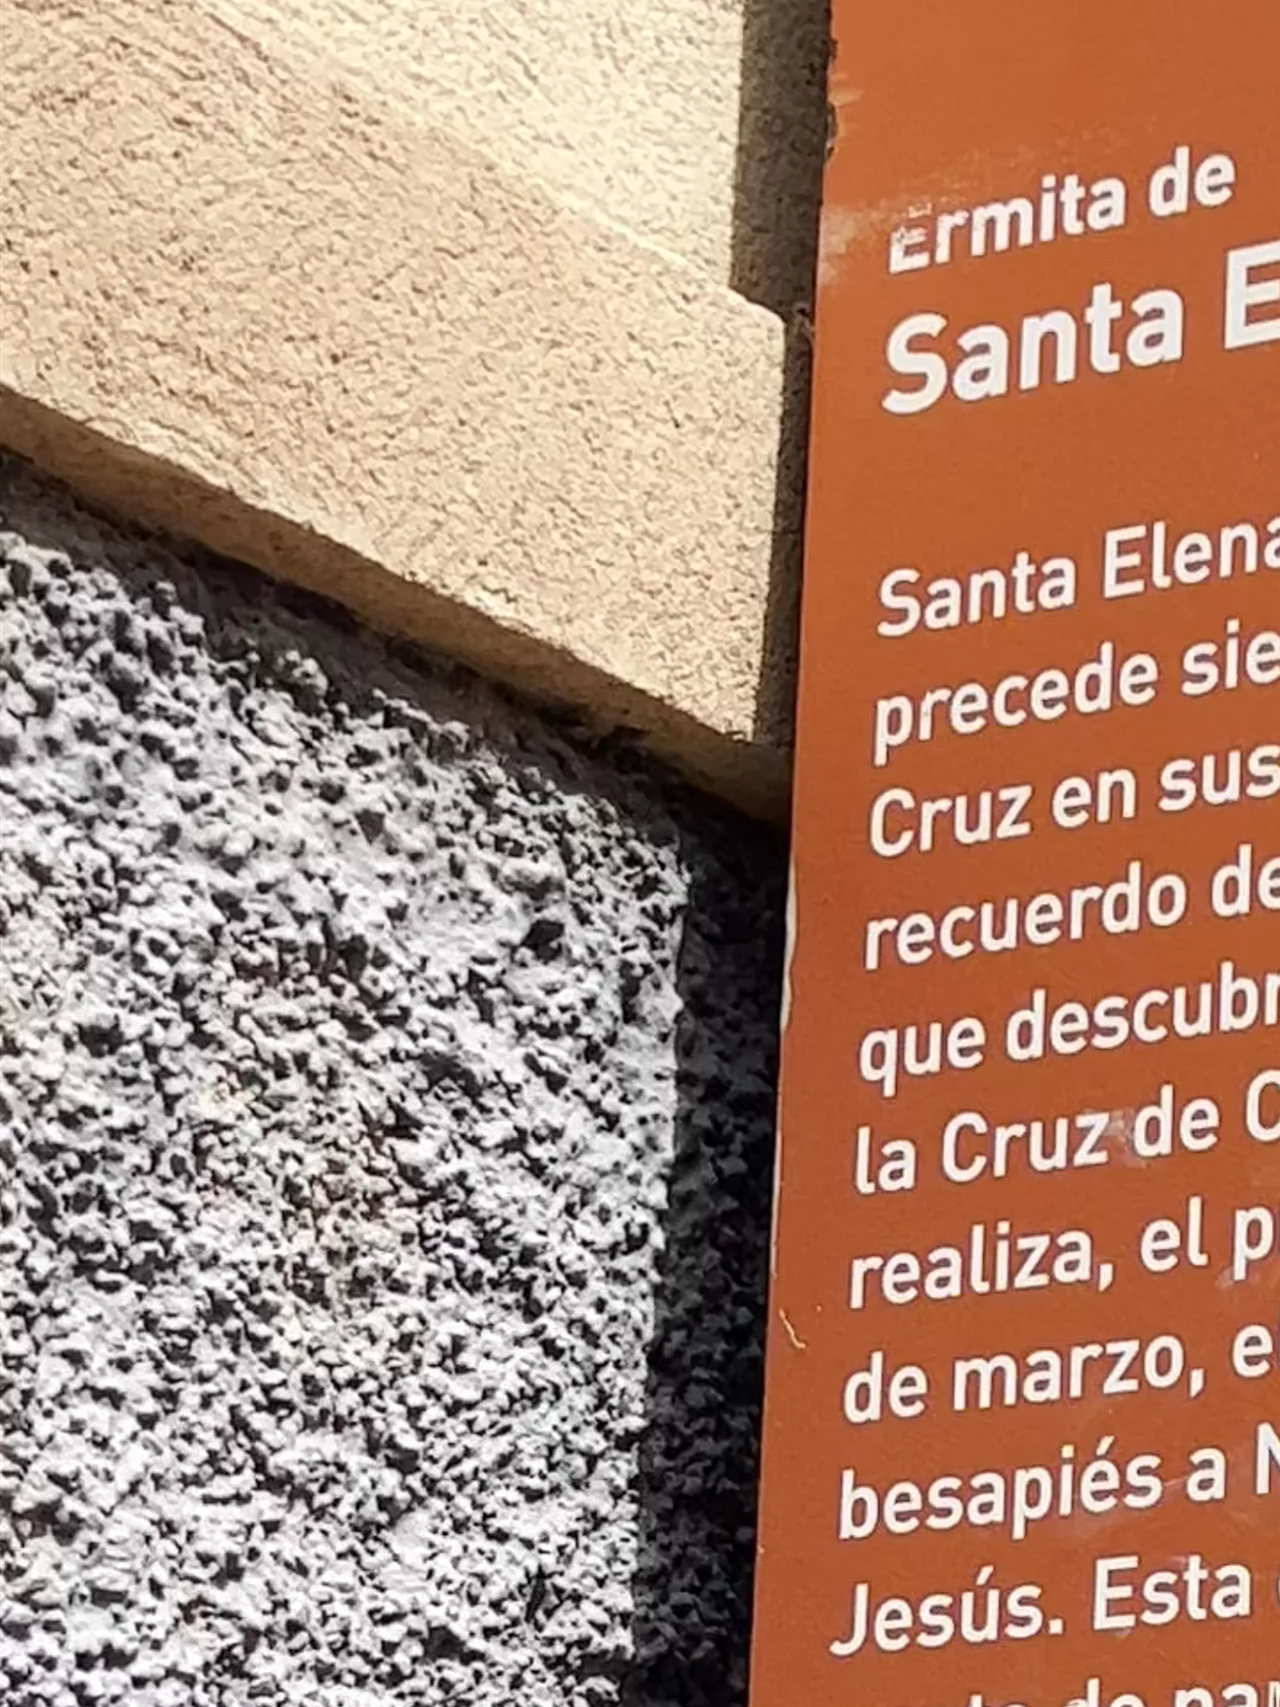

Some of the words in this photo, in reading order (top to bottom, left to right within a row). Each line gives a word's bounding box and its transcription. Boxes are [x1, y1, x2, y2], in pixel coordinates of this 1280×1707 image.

[888, 173, 1127, 275] Ermita
[1148, 145, 1236, 218] de
[881, 282, 1184, 415] Santa
[876, 551, 1077, 637] Santa
[873, 640, 1159, 767] precede
[870, 784, 1033, 858] Cruz
[1051, 768, 1137, 829] en
[864, 860, 1187, 971] recuerdo
[858, 1016, 986, 1098] que
[855, 1125, 917, 1195] la
[941, 1111, 1111, 1184] Cruz
[1132, 1082, 1221, 1160] de
[849, 1220, 1114, 1310] realiza,
[1139, 1195, 1209, 1273] el
[843, 1350, 928, 1424] de
[952, 1334, 1205, 1412] marzo,
[838, 1434, 1164, 1541] besapiés
[1185, 1447, 1227, 1502] a
[828, 1564, 1064, 1657] Jesús.
[1092, 1554, 1252, 1631] Esta
